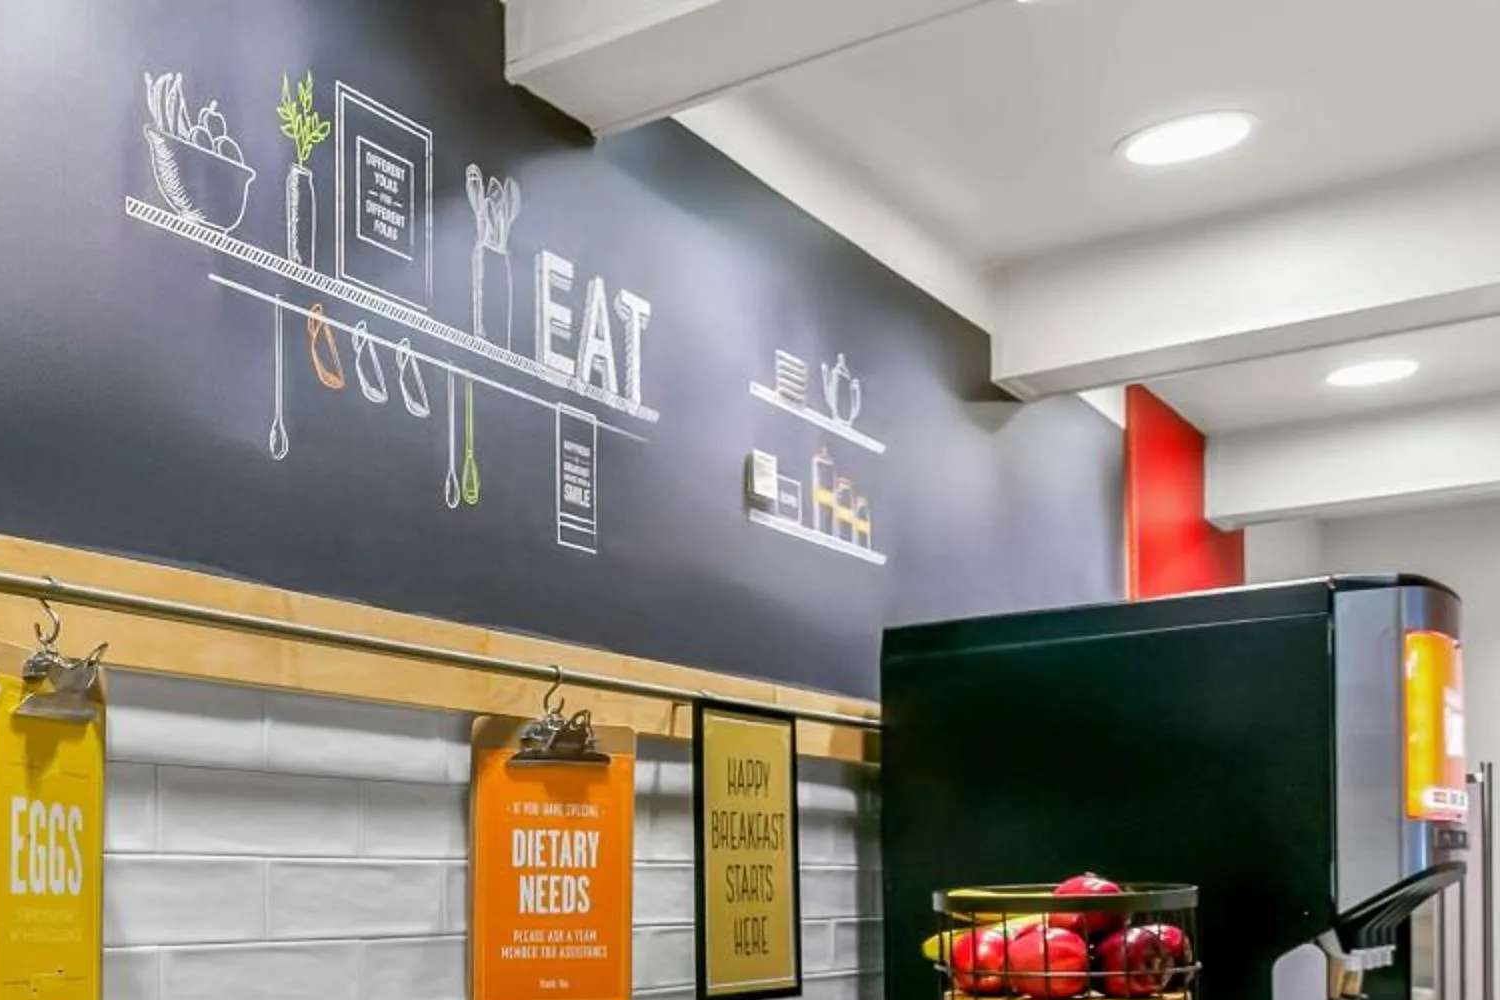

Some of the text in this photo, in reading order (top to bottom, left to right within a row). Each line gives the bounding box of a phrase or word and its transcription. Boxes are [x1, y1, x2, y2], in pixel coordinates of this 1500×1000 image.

[366, 151, 405, 181] DIFFERENT
[366, 199, 405, 228] DIFFERENT
[535, 250, 651, 405] EAT
[727, 757, 771, 798] HAPPY
[9, 795, 83, 896] EGGS
[512, 828, 601, 868] DIETARY
[711, 810, 787, 850] BREAKFAST
[518, 875, 591, 914] NEEDS
[725, 864, 774, 904] STARTS
[513, 929, 545, 944] PLEASE
[566, 930, 573, 942] A
[733, 916, 770, 956] HERE
